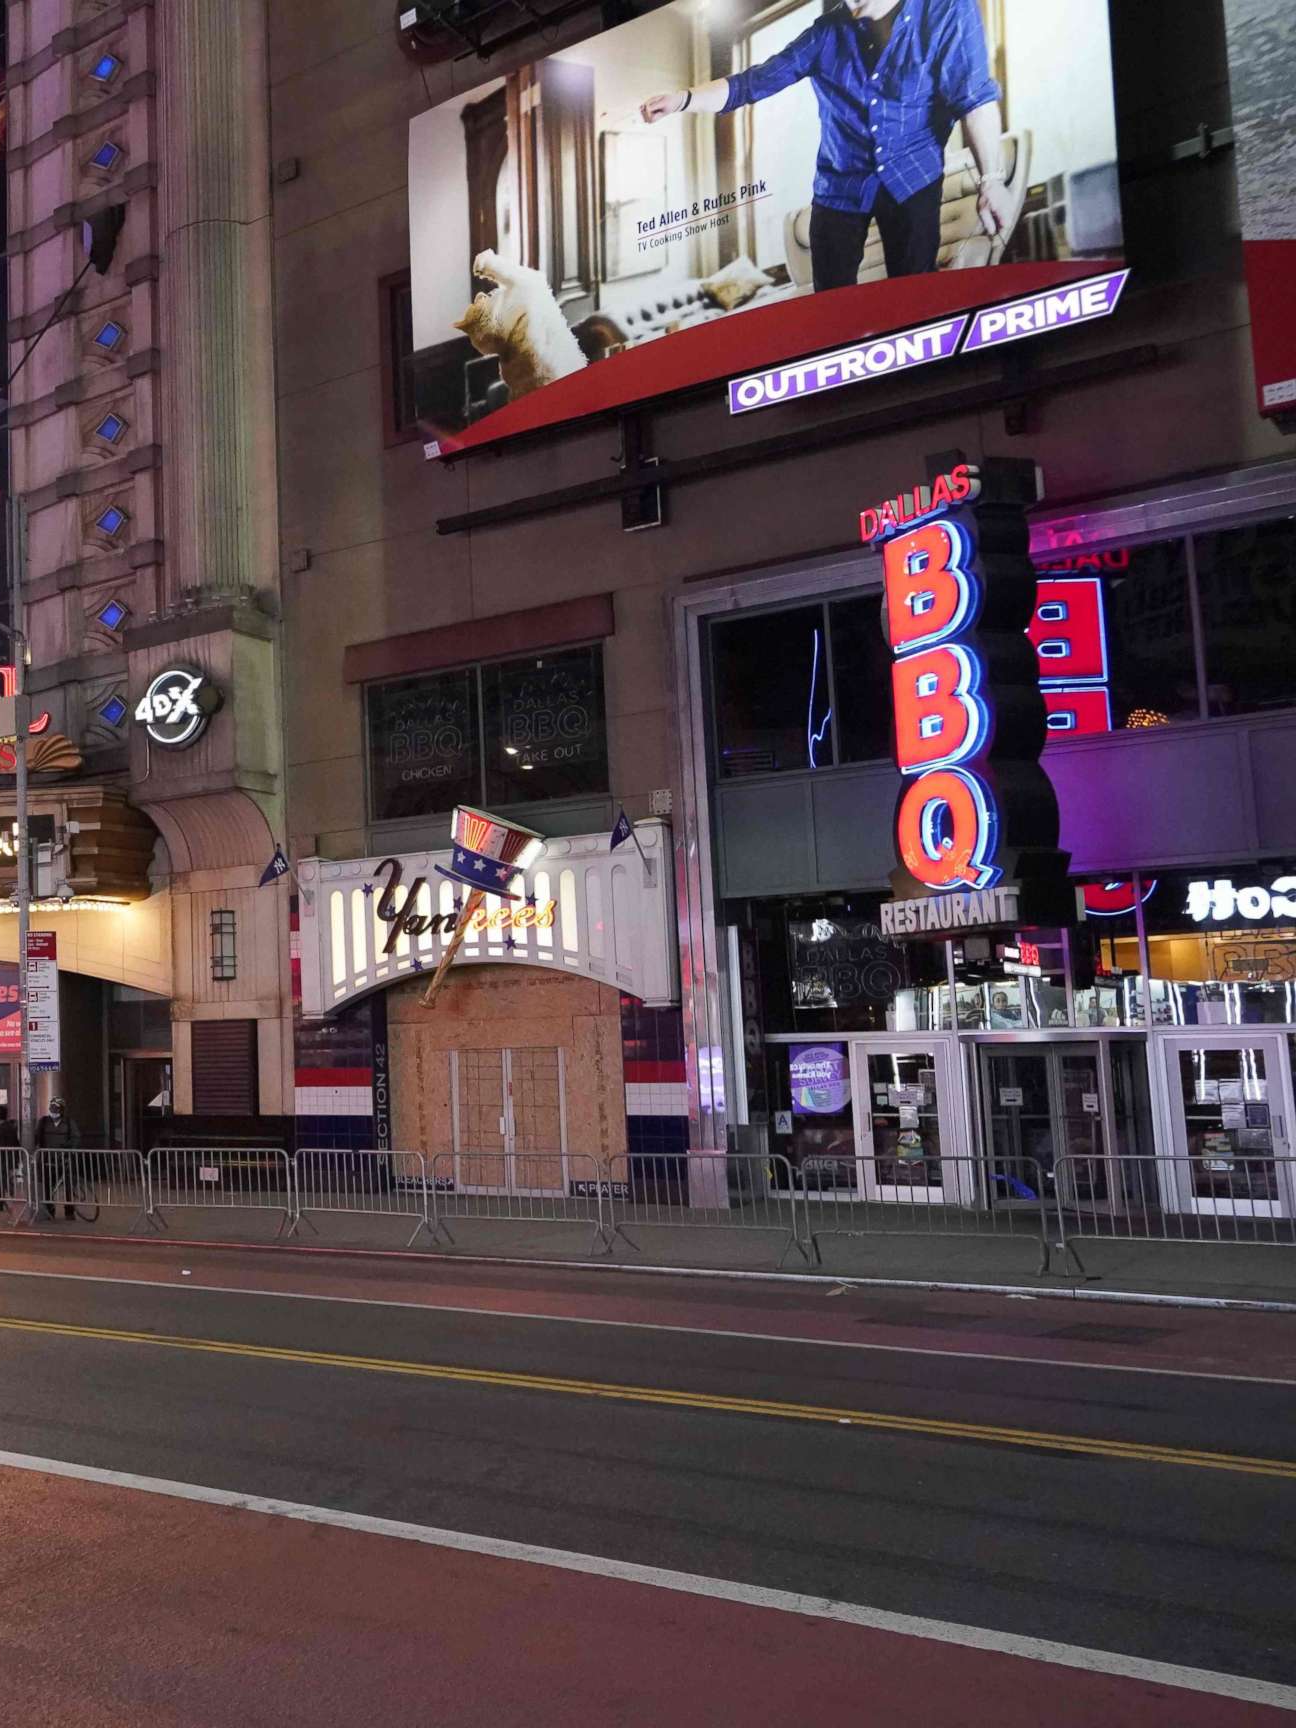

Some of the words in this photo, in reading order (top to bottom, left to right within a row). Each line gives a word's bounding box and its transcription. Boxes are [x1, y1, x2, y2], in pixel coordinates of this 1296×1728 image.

[637, 216, 655, 234] Ted
[660, 208, 687, 226] Allen
[691, 202, 699, 216] &
[703, 191, 736, 213] Rufus
[740, 179, 767, 200] Pink
[637, 241, 647, 253] TV
[650, 229, 682, 249] Cooking
[685, 222, 707, 238] Show
[710, 214, 729, 229] Host
[737, 324, 953, 408] OUTFRONT
[981, 281, 1110, 342] PRIME
[859, 463, 972, 542] DALLAS
[134, 677, 203, 724] 4DX
[883, 521, 1002, 890] BBQ
[402, 765, 452, 781] CHICKEN
[554, 744, 582, 759] OUT
[881, 887, 1007, 936] RESTAURANT
[375, 1042, 386, 1068] 42
[777, 1114, 789, 1126] A
